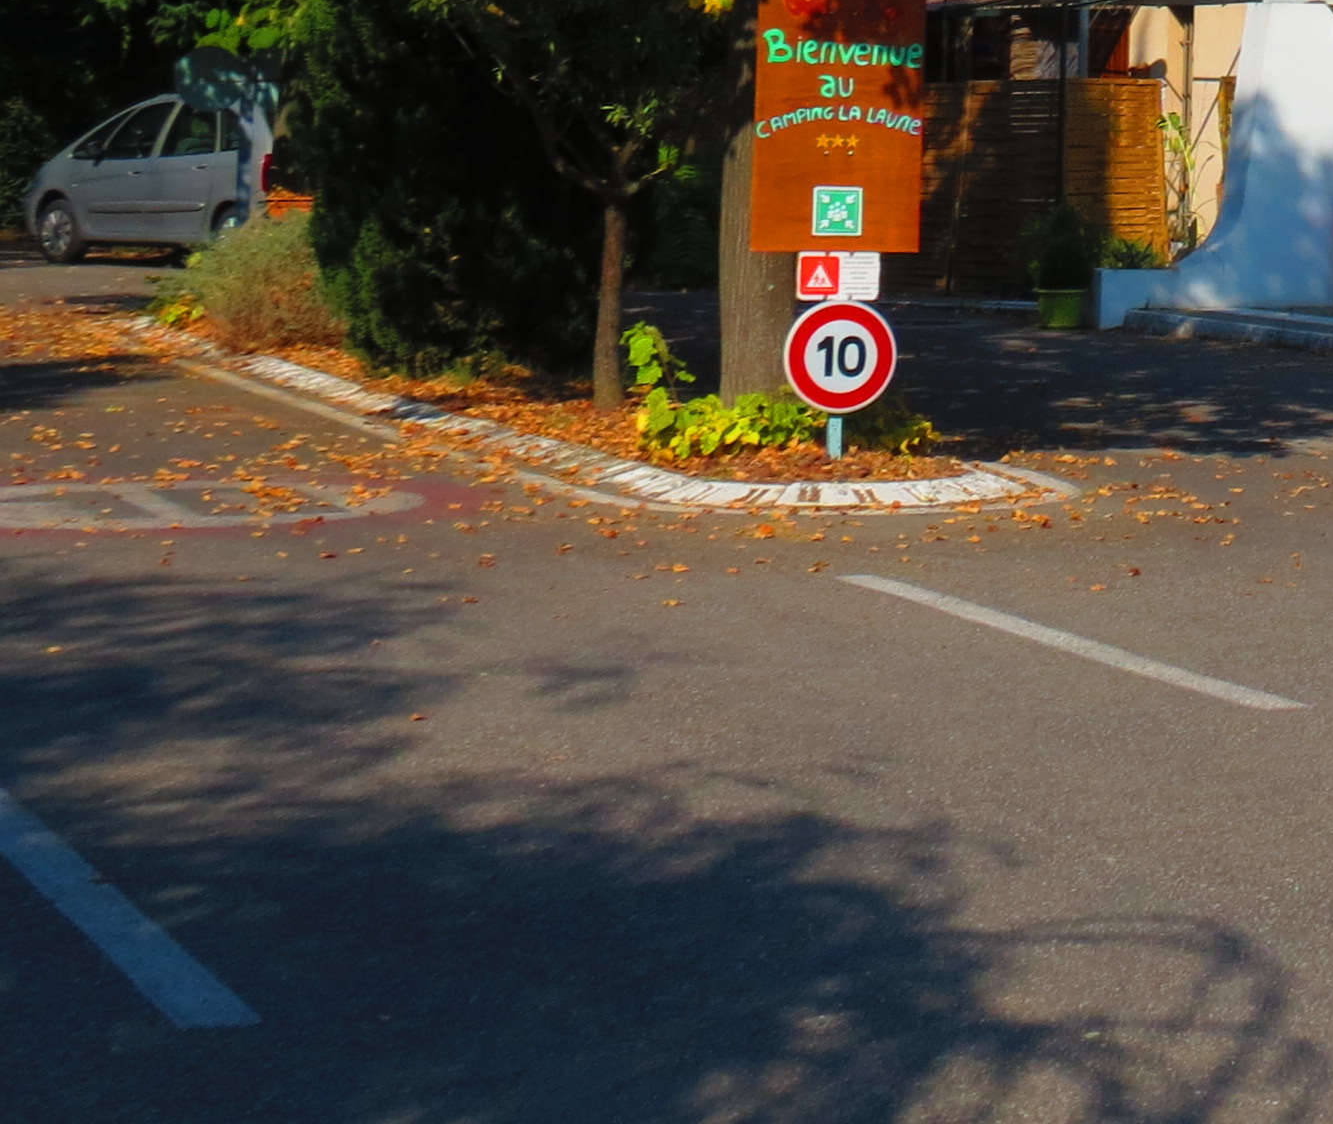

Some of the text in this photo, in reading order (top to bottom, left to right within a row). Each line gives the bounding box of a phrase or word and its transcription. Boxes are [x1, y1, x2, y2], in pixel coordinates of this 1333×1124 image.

[763, 28, 924, 69] Bienvenue
[818, 74, 855, 98] au
[838, 105, 862, 121] LA
[817, 335, 867, 378] 10
